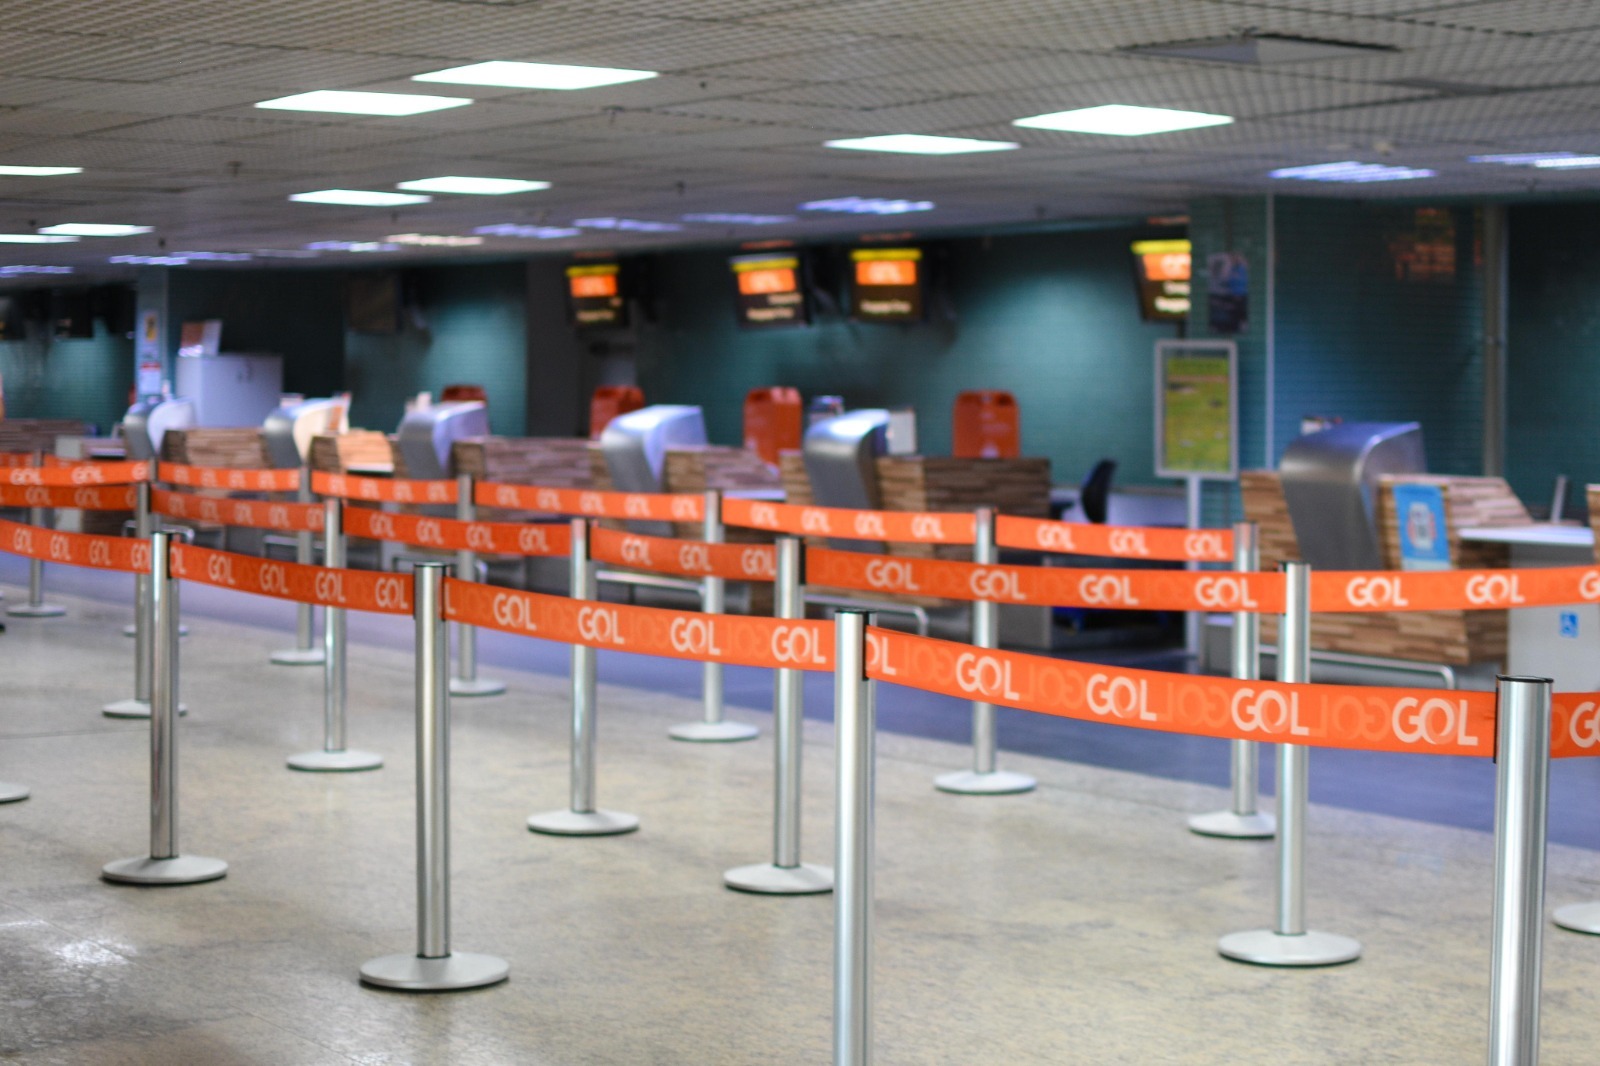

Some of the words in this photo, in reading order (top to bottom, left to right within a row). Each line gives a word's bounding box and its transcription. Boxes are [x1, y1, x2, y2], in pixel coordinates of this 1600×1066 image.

[624, 494, 653, 516] GOL
[671, 496, 699, 519] GOL
[751, 503, 779, 527] GOL
[801, 509, 832, 533] GOL
[854, 512, 886, 536] GOL
[912, 516, 945, 540] GOL
[13, 527, 34, 555] GOL
[50, 534, 72, 562] GOL
[89, 540, 112, 567] GOL
[369, 512, 396, 538] GOL
[416, 519, 445, 545] GOL
[465, 524, 496, 549] GOL
[518, 526, 549, 552] GOL
[1037, 524, 1076, 551] GOL
[1109, 530, 1149, 556] GOL
[1184, 533, 1227, 559] GOL
[620, 537, 653, 566] GOL
[679, 545, 712, 572] GOL
[741, 547, 776, 577] GOL
[208, 553, 236, 585] GOL
[259, 563, 290, 595] GOL
[315, 572, 347, 603] GOL
[375, 577, 408, 610] GOL
[865, 560, 920, 591] GOL
[969, 568, 1027, 600] GOL
[1078, 574, 1140, 605] GOL
[1194, 577, 1260, 608] GOL
[1345, 576, 1409, 607] GOL
[1465, 574, 1526, 604] GOL
[493, 593, 537, 631] GOL
[578, 606, 626, 645] GOL
[670, 617, 722, 656] GOL
[771, 626, 827, 665] GOL
[866, 632, 897, 676] OL
[956, 652, 1020, 702] GOL
[1086, 673, 1157, 722] GOL
[1230, 688, 1309, 736] GOL
[1391, 696, 1479, 746] GOL
